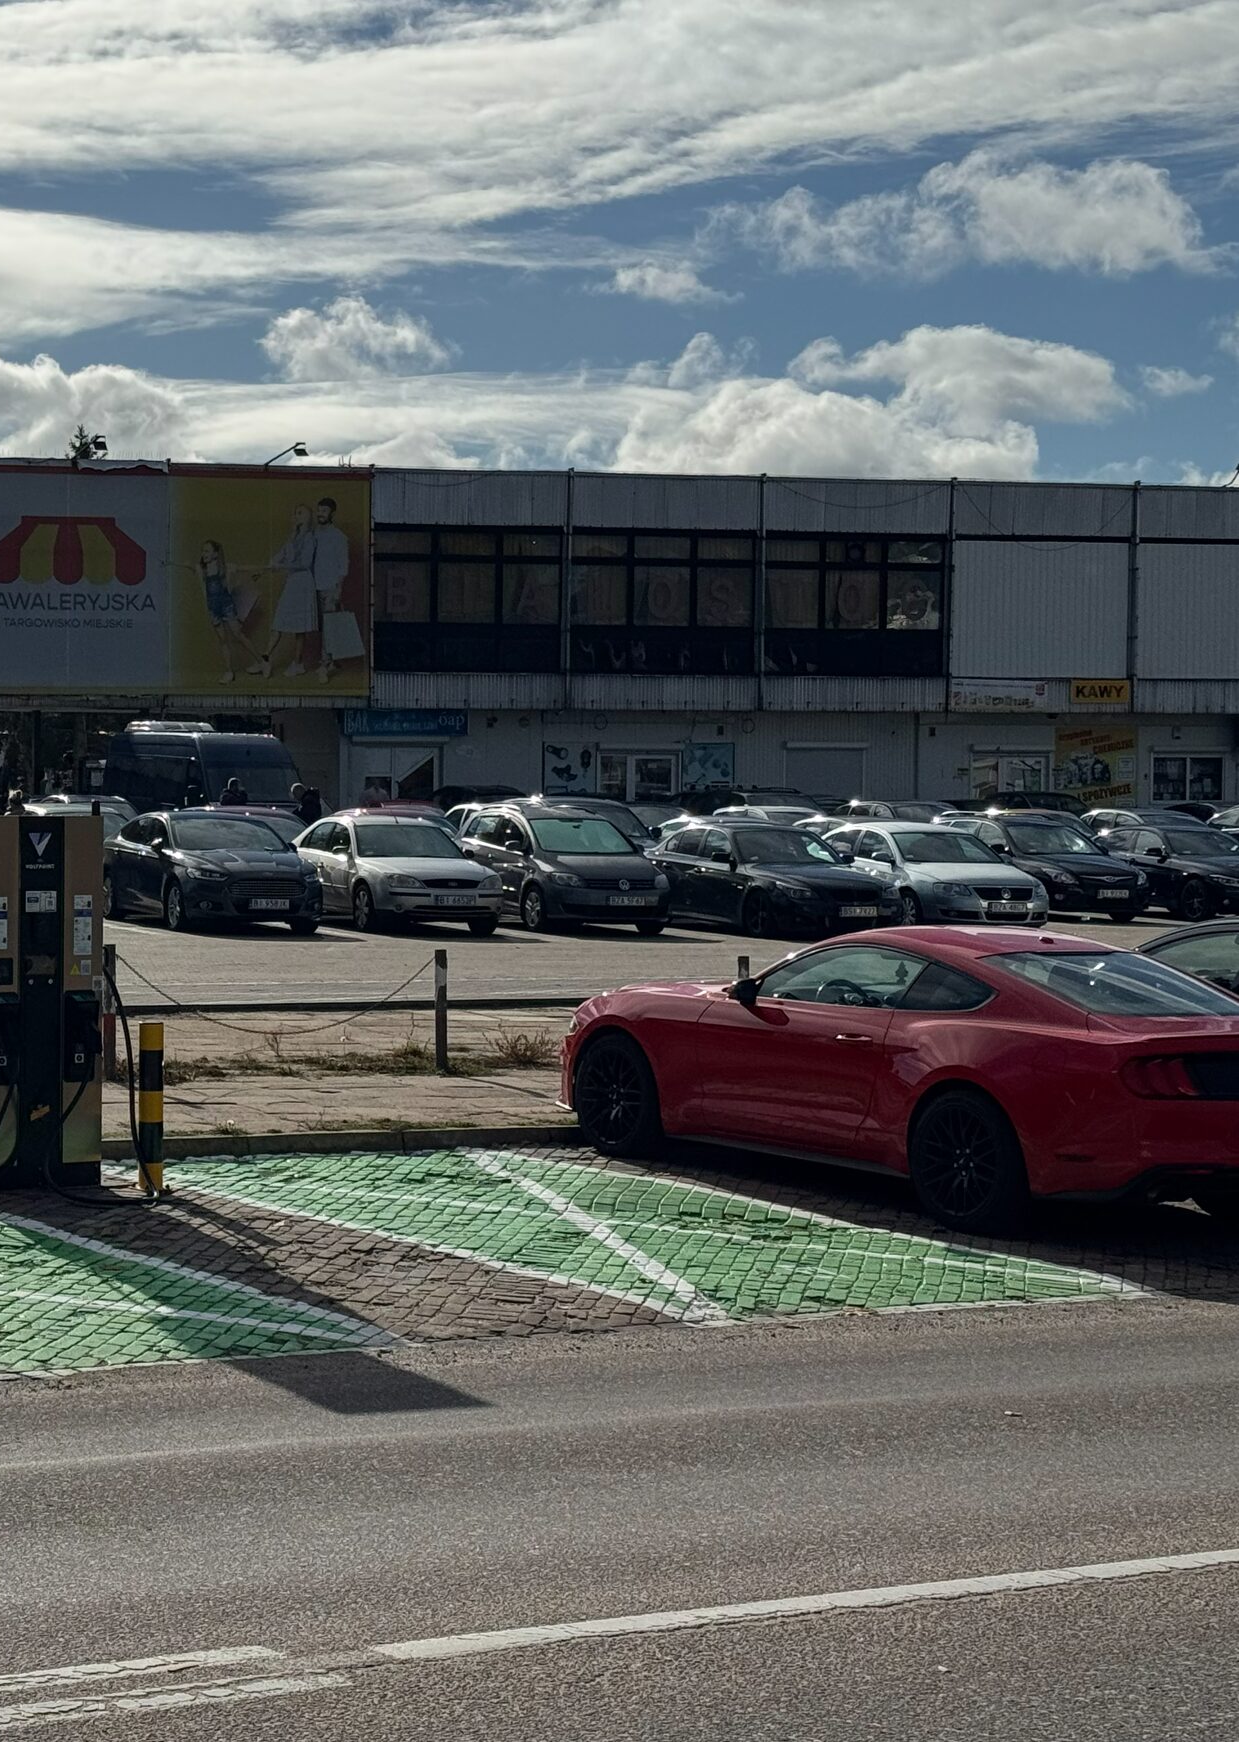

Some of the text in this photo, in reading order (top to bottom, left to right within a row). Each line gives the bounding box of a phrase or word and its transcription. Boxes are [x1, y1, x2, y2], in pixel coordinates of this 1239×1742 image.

[3, 617, 134, 629] TARGOWISKO MIEJSKIE
[1075, 685, 1125, 699] KAWY
